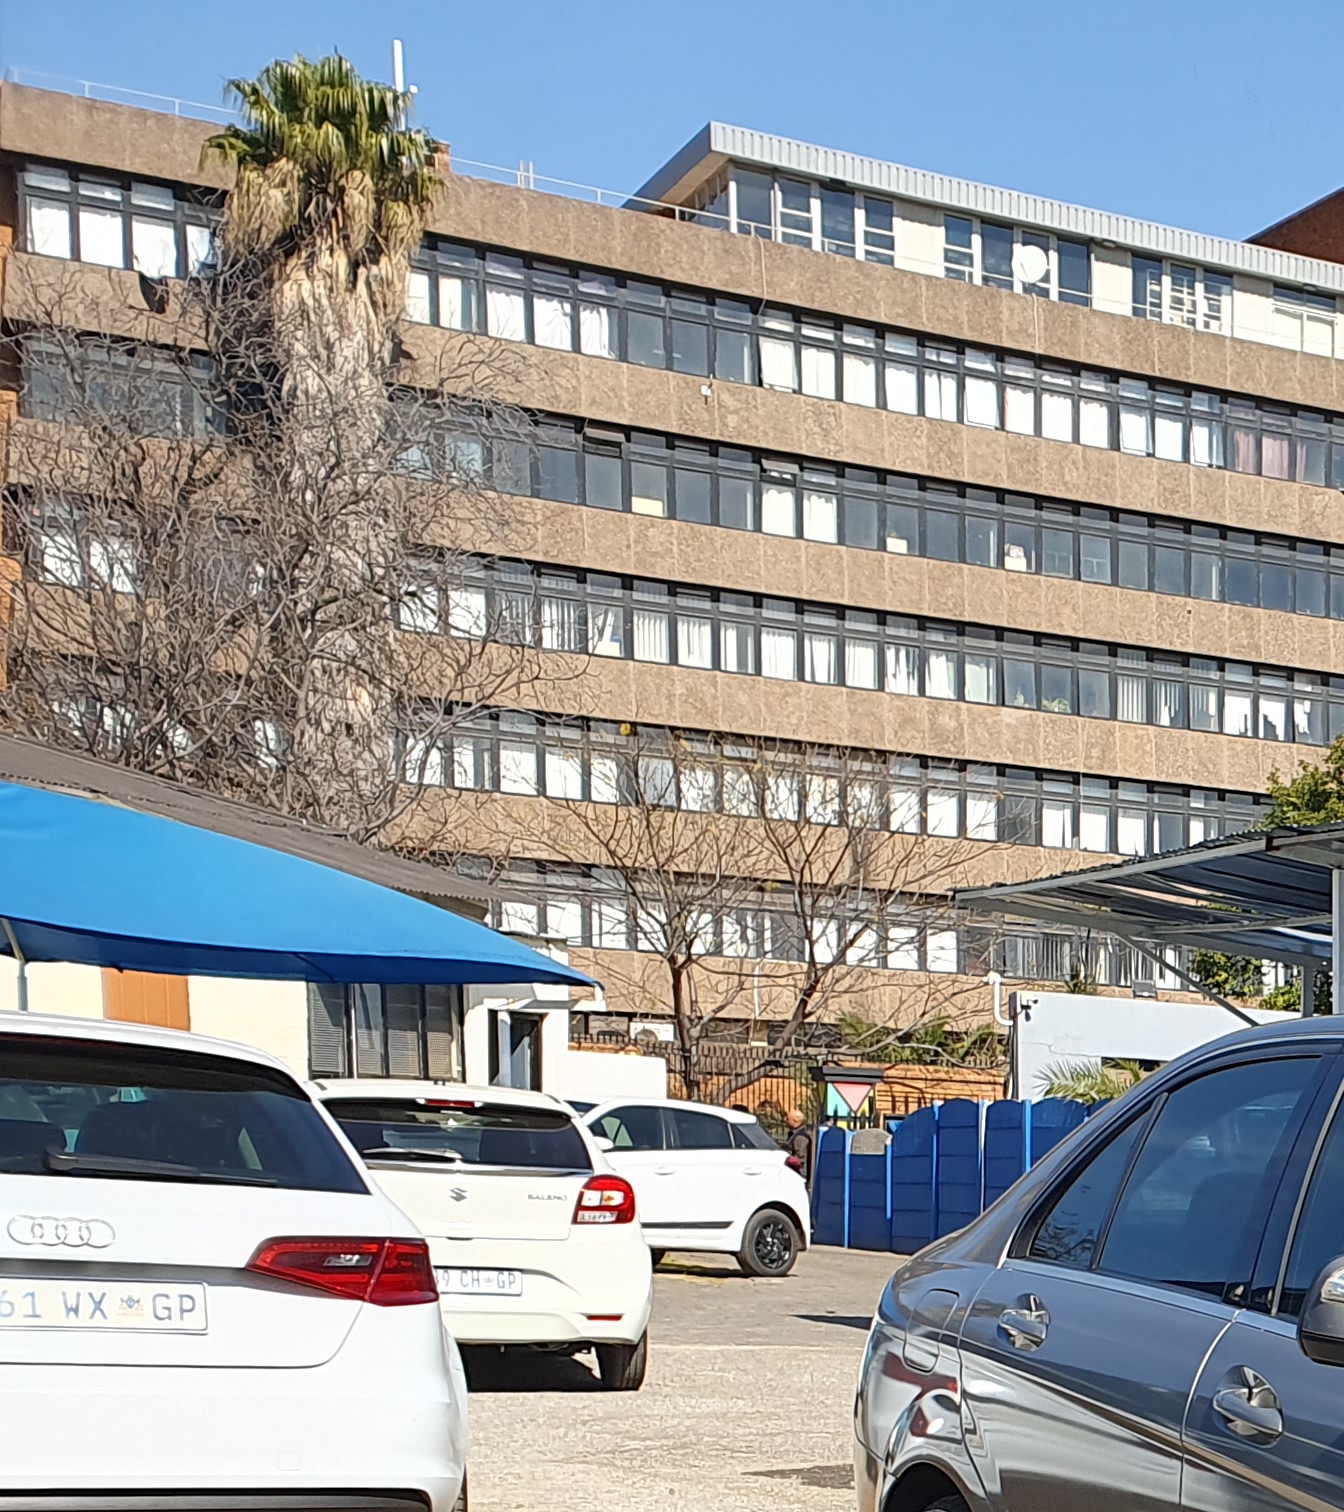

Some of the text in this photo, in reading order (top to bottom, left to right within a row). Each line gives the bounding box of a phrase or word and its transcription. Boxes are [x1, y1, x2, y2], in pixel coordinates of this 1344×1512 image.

[460, 1269, 481, 1289] CH
[497, 1271, 516, 1290] GP
[61, 1290, 109, 1320] WX
[151, 1293, 197, 1321] GP
